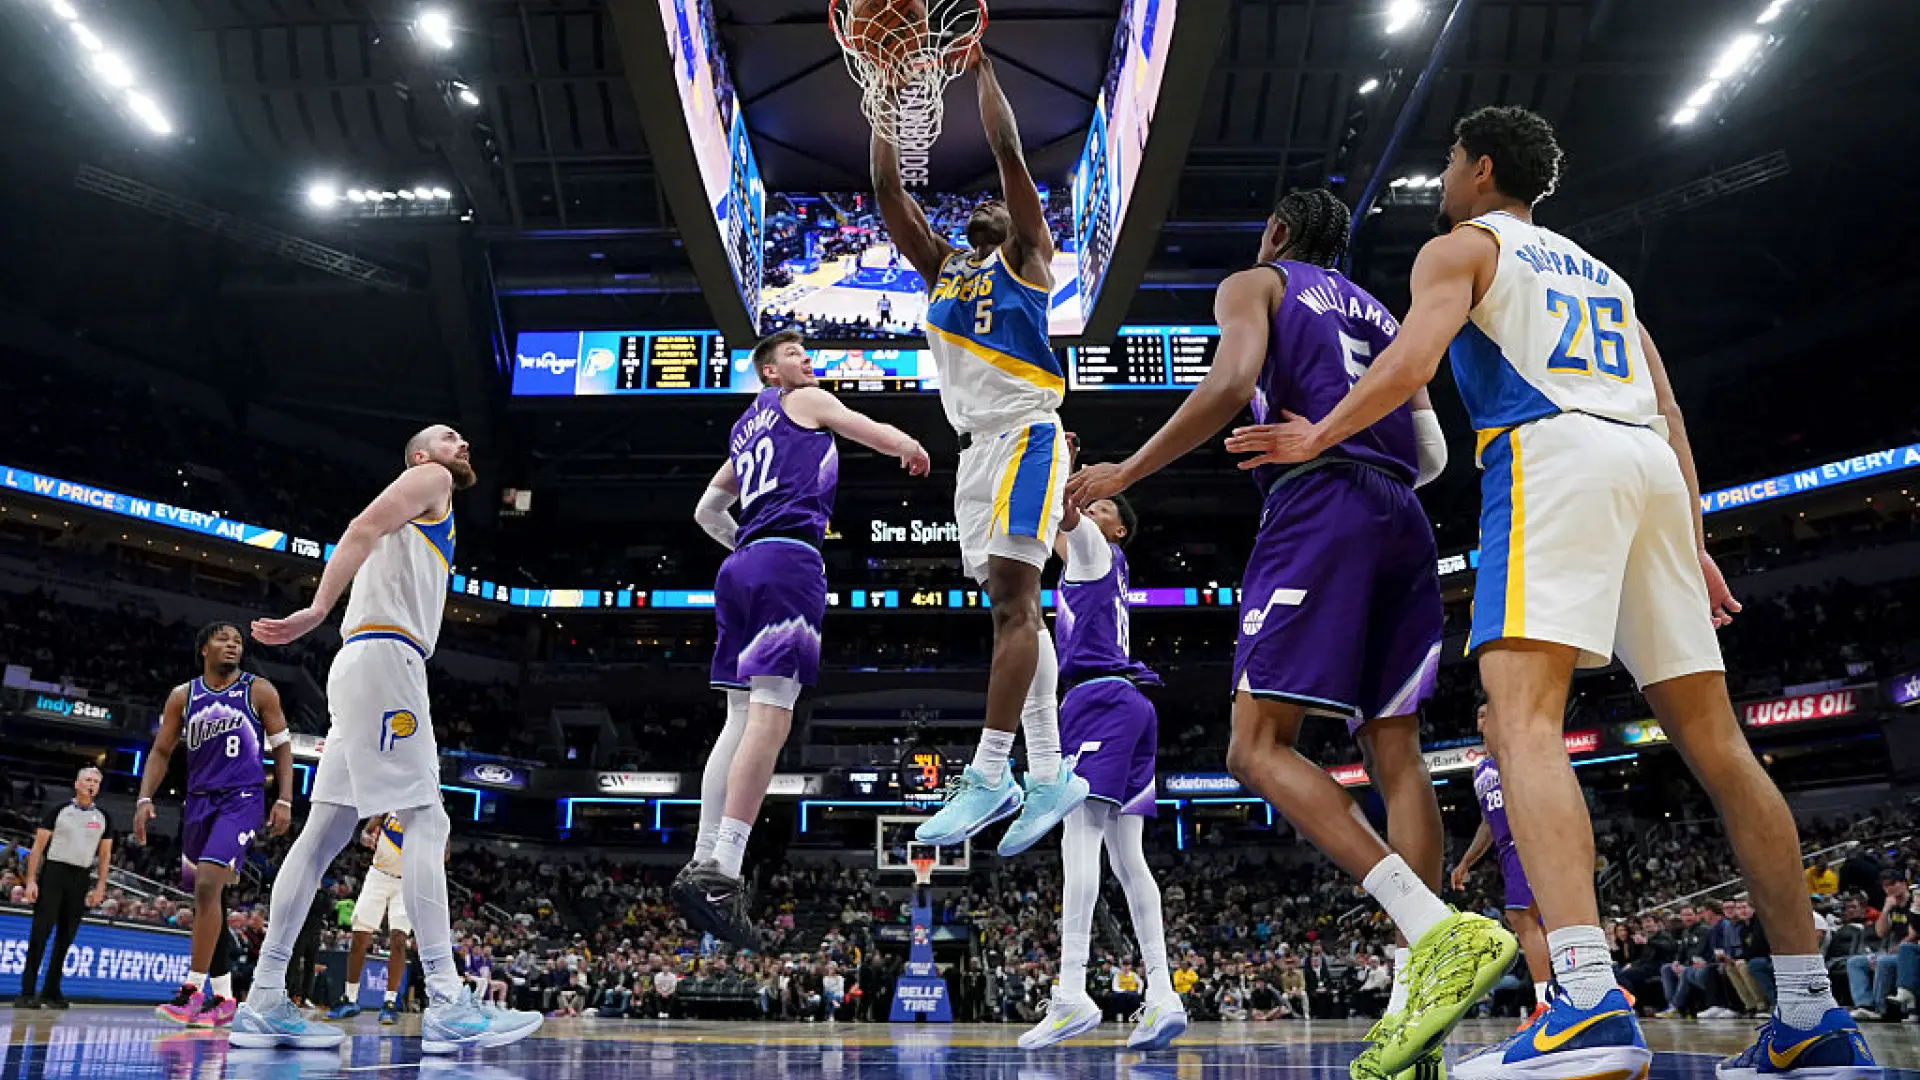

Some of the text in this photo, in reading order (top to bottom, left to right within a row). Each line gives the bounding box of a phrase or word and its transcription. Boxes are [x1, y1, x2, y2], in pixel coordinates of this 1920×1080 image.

[974, 299, 992, 334] 5
[1546, 288, 1634, 384] 26
[1338, 329, 1371, 391] 5
[736, 436, 779, 509] 22
[1716, 479, 1790, 508] PRICES
[1794, 470, 1819, 490] IN
[1823, 449, 1895, 479] EVERY
[57, 481, 125, 511] PRICES
[130, 499, 151, 518] IN
[155, 503, 213, 529] EVERY
[871, 519, 906, 542] Sire
[911, 591, 942, 606] 4:41
[1746, 692, 1856, 725] LUCAS OIL
[188, 716, 243, 751] UTAH
[225, 736, 241, 758] 8
[923, 765, 938, 787] 9
[1165, 775, 1240, 790] ticketmaste
[1487, 790, 1502, 812] 28
[62, 944, 95, 978] OR
[96, 947, 192, 984] EVERYONE
[898, 986, 943, 999] BELLE
[903, 999, 937, 1013] TIRE
